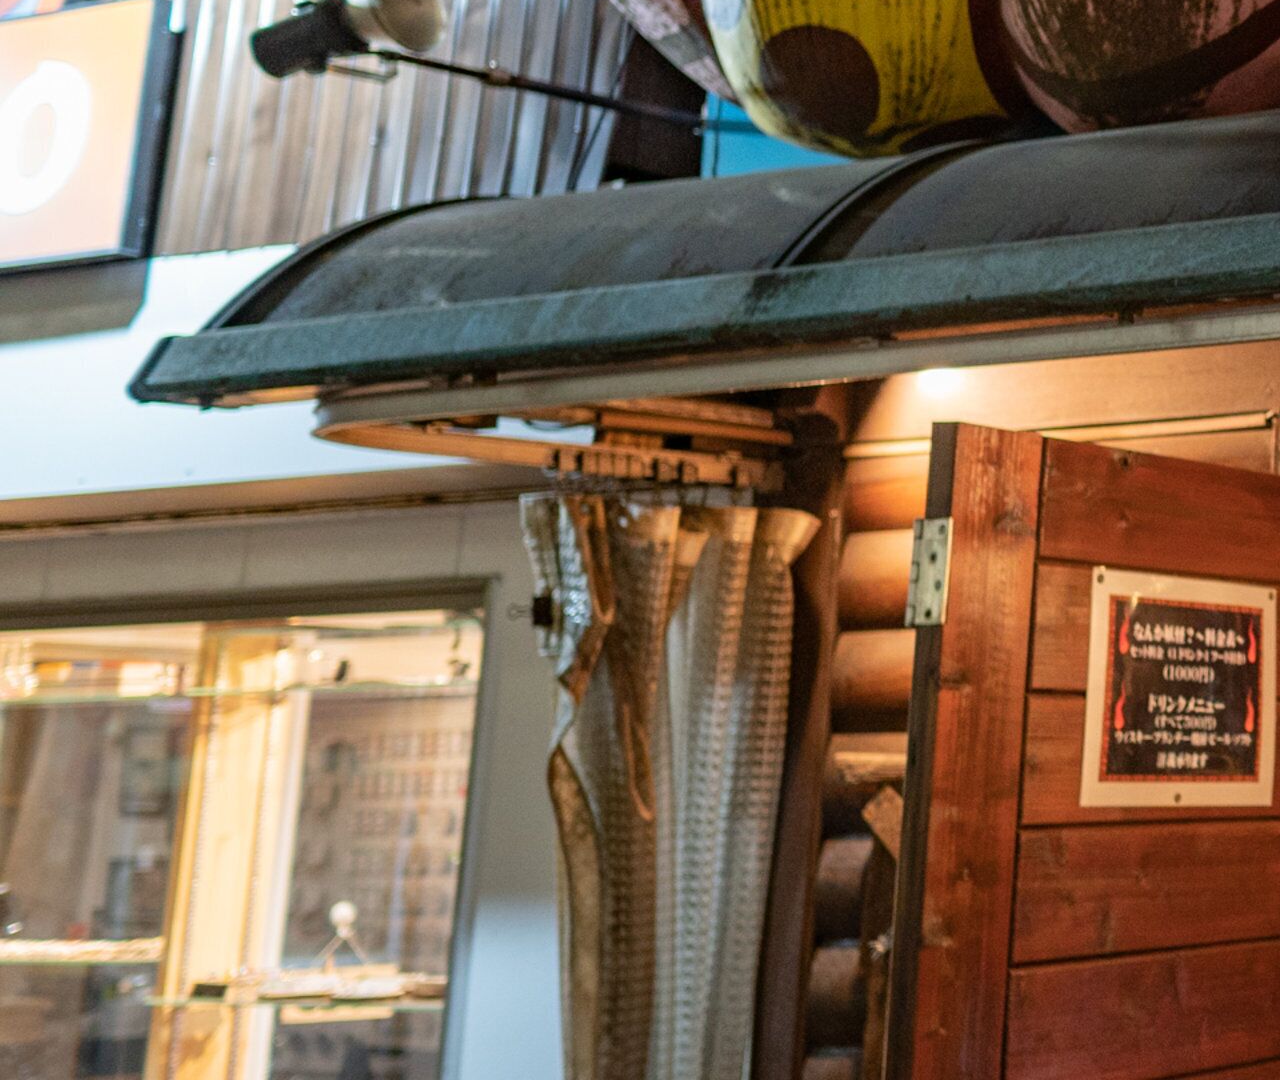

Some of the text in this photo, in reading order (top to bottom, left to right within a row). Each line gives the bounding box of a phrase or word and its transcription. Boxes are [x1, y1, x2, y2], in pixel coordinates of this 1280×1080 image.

[1148, 693, 1226, 714] ドリンクメニュー
